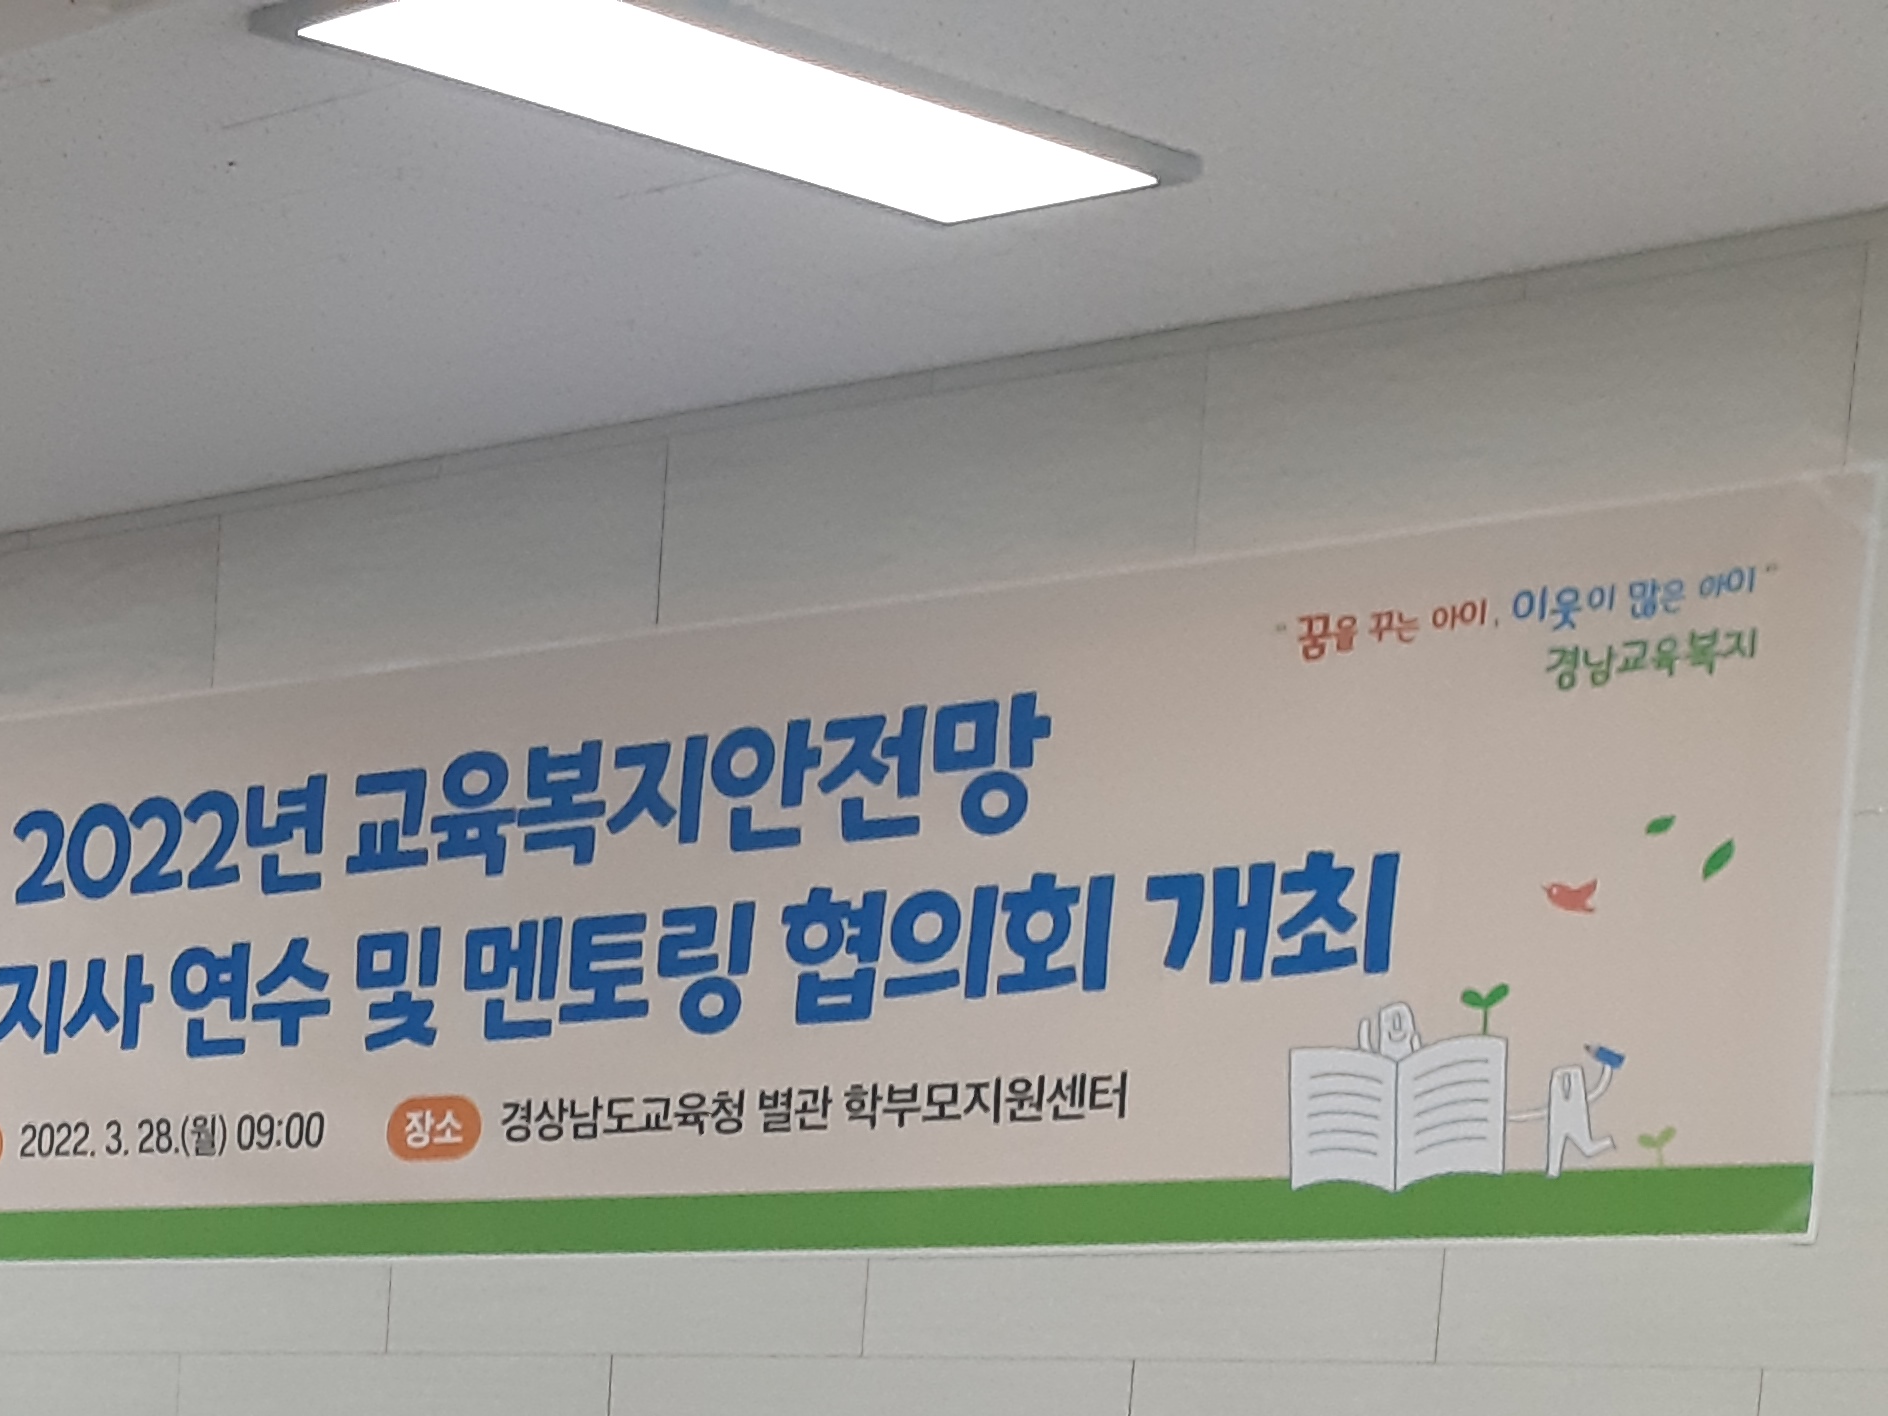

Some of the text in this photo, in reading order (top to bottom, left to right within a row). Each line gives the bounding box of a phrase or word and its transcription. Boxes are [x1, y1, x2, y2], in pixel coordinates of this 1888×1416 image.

[1369, 610, 1420, 643] 꾸는
[1512, 583, 1615, 631] 이웃이
[1628, 578, 1685, 620] 많은
[1546, 628, 1758, 690] 경남교육복지
[13, 691, 1052, 906] 2022년 교육복지안전망
[170, 937, 332, 1059] 연수
[354, 926, 442, 1054] 및
[465, 900, 756, 1046] 멘토링
[780, 872, 1115, 1027] 협의회
[1145, 850, 1401, 985] 개최
[19, 1124, 97, 1161] 2022.
[104, 1121, 131, 1157] 3.
[137, 1115, 229, 1160] 28.(월)
[236, 1110, 326, 1154] 09:00
[404, 1070, 1130, 1149] 장소 경상남도교육청 별관 학부모지원센터
